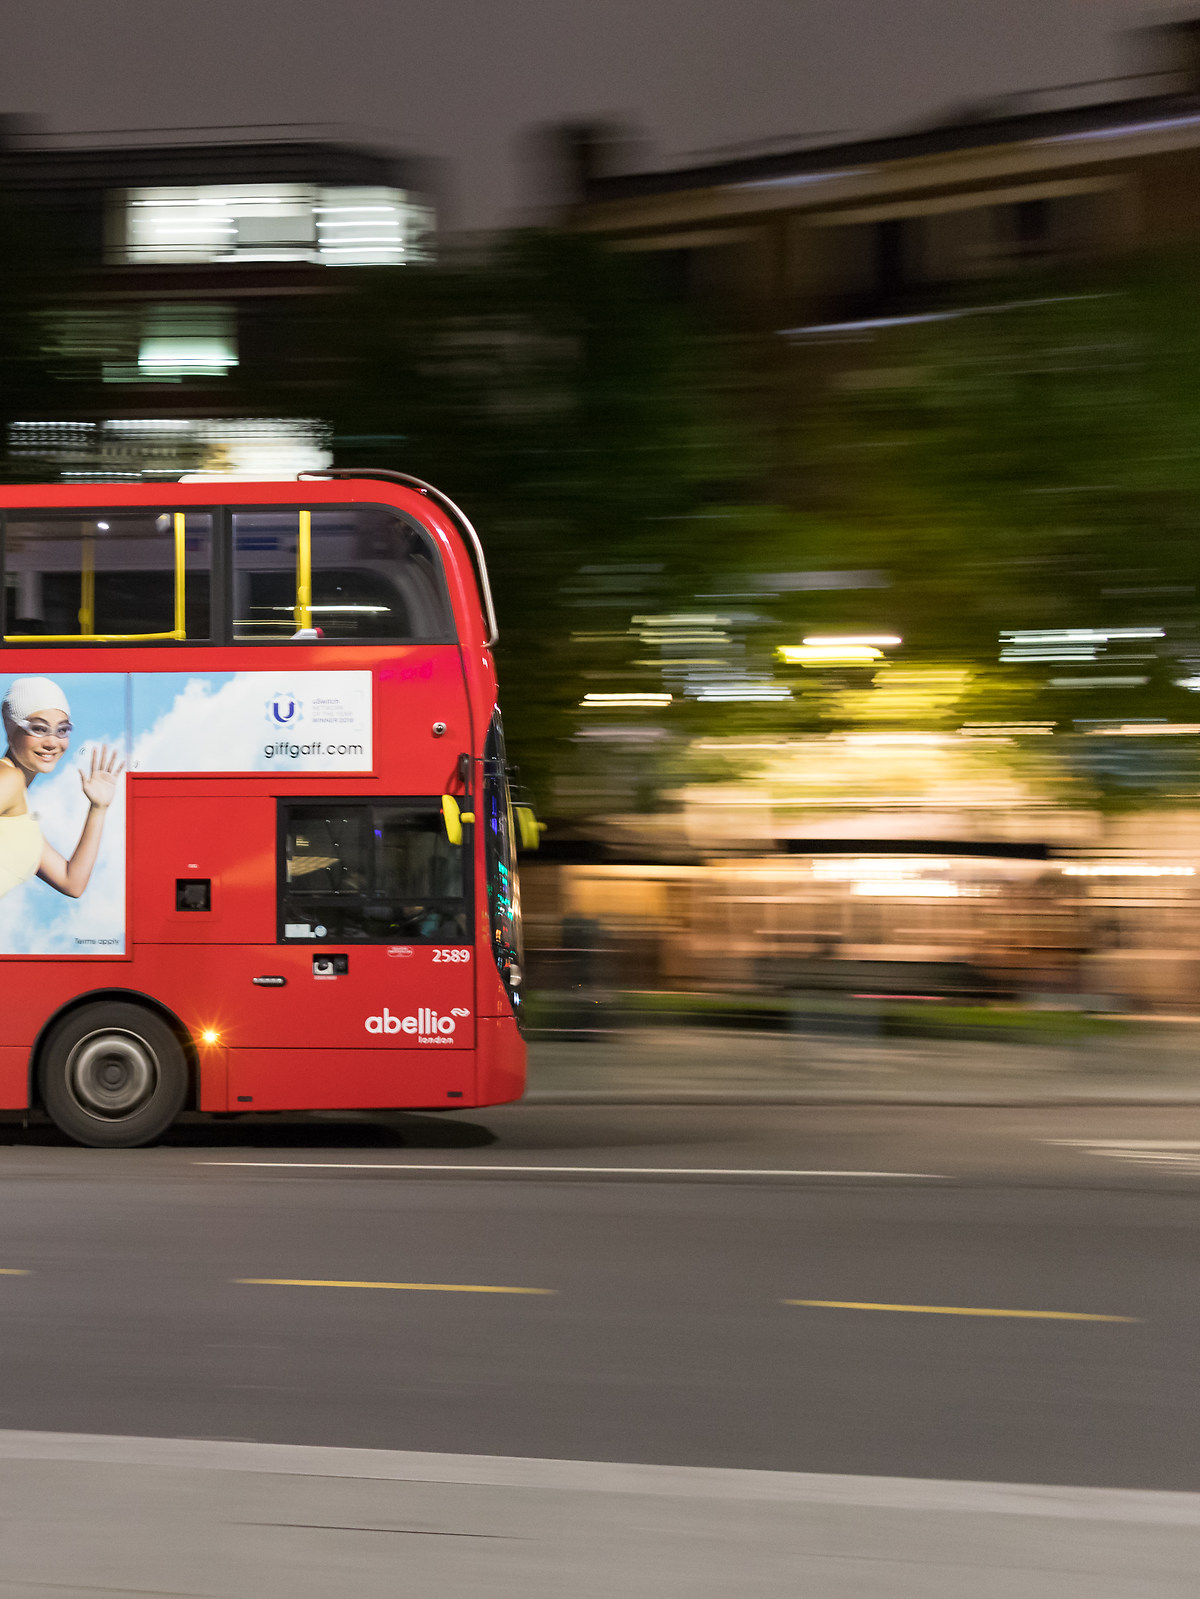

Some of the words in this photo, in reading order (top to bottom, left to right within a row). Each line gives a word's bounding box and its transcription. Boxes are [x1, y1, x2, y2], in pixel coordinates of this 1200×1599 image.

[264, 742, 364, 759] giffgaff.com
[432, 949, 471, 963] 2589
[364, 1007, 456, 1035] abellio
[418, 1035, 454, 1045] london
